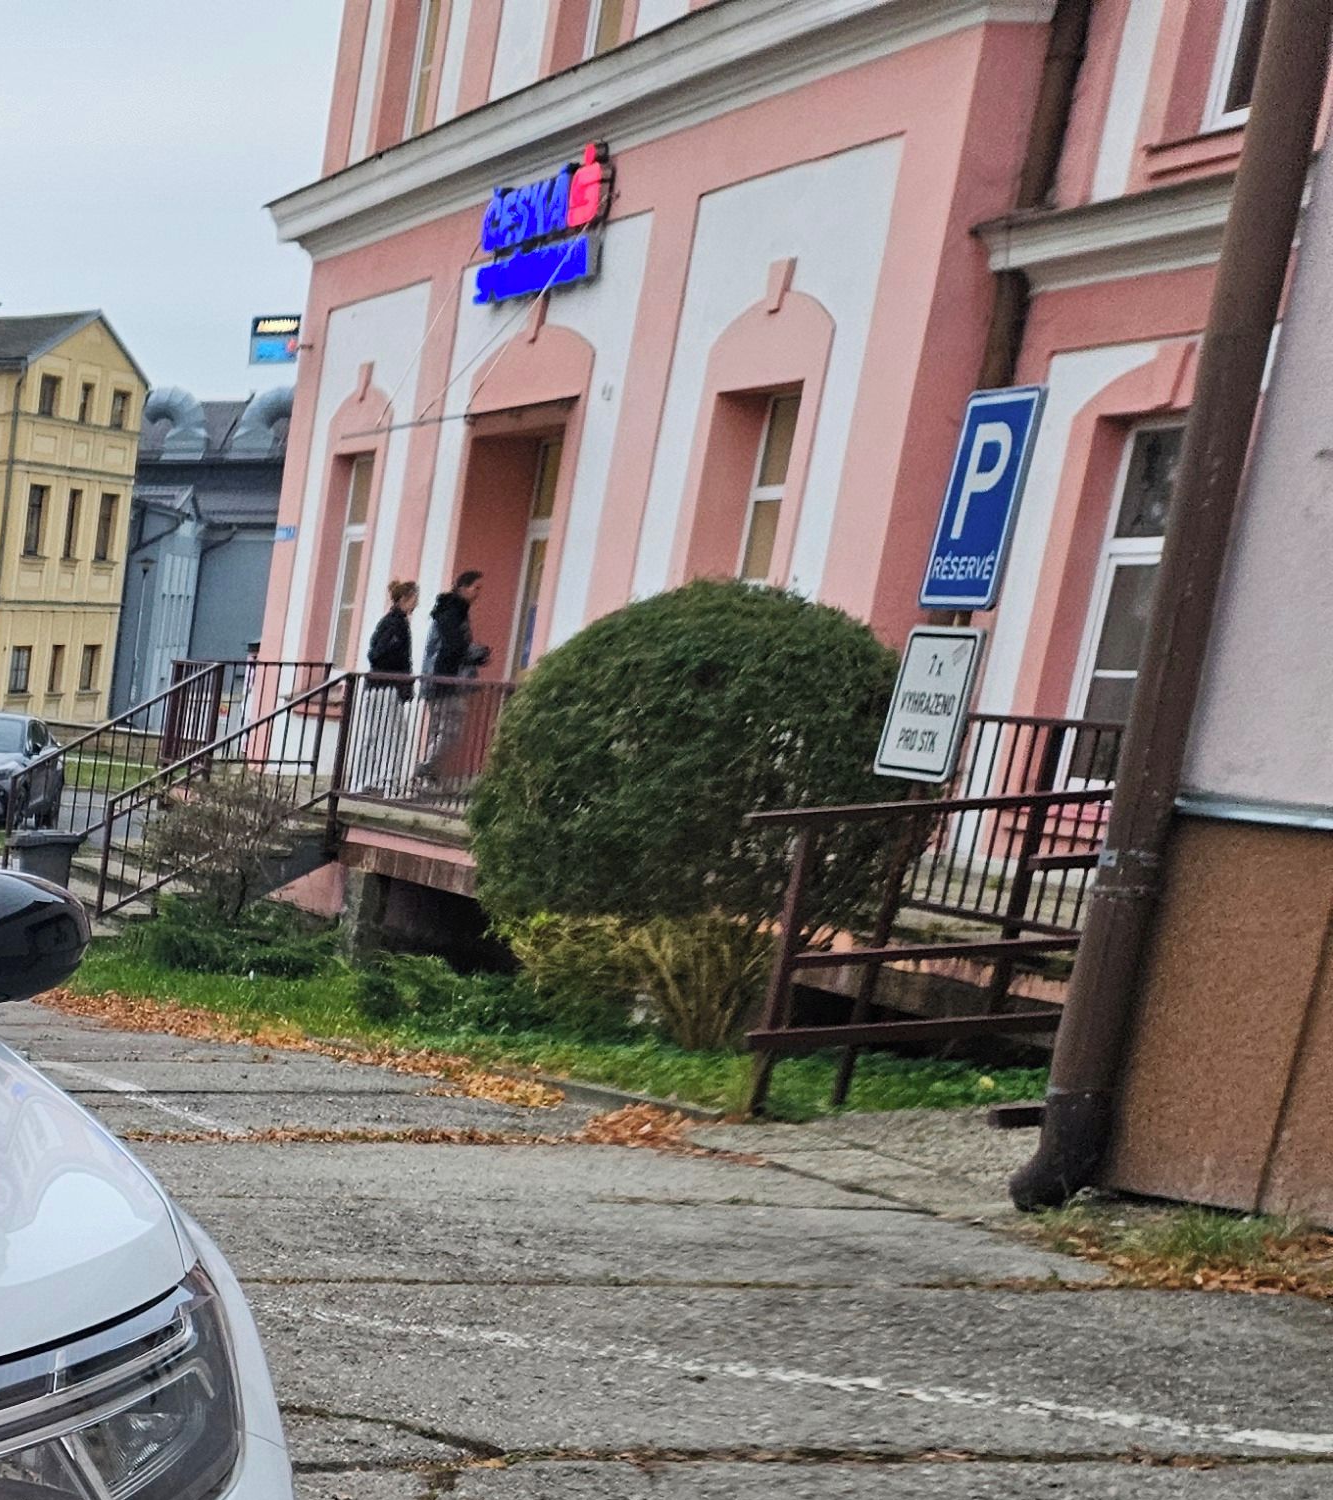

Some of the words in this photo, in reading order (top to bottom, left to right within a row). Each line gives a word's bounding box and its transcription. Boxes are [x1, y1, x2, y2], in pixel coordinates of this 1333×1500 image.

[950, 421, 1013, 541] P
[930, 550, 996, 582] RÉSERVÉ
[896, 727, 919, 751] PRO
[917, 730, 939, 753] STK
